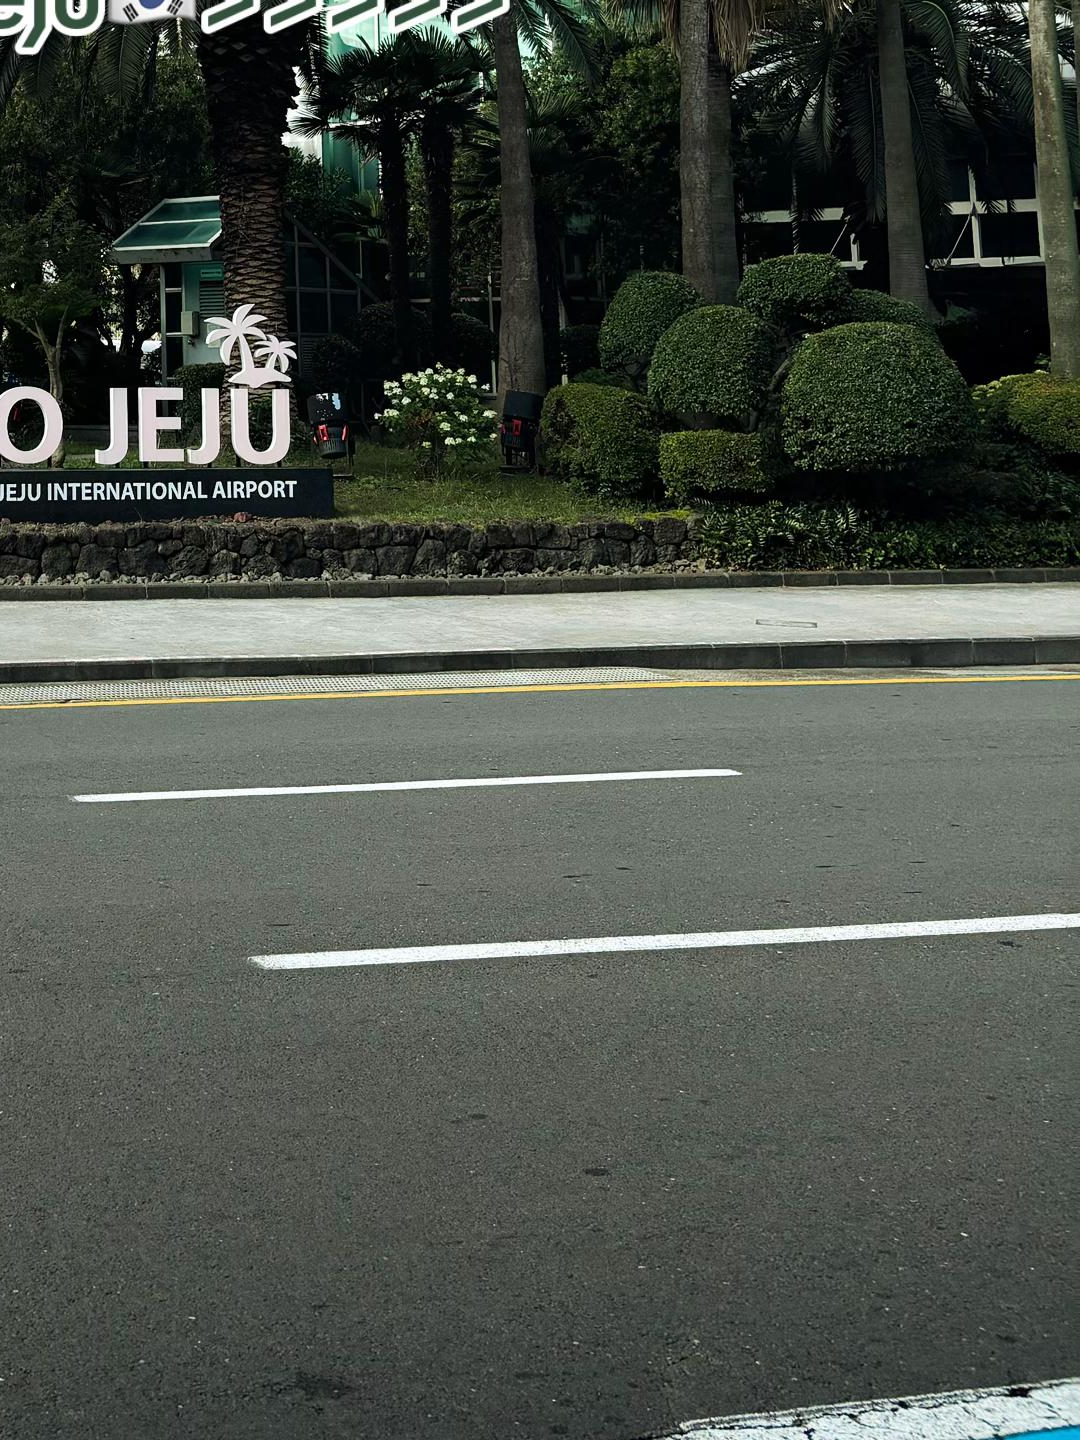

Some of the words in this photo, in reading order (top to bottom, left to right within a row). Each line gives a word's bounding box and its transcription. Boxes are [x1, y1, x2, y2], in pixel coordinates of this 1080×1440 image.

[95, 387, 291, 465] JEJU
[47, 481, 208, 501] INTERNATIONAL
[212, 480, 298, 499] AIRPORT
